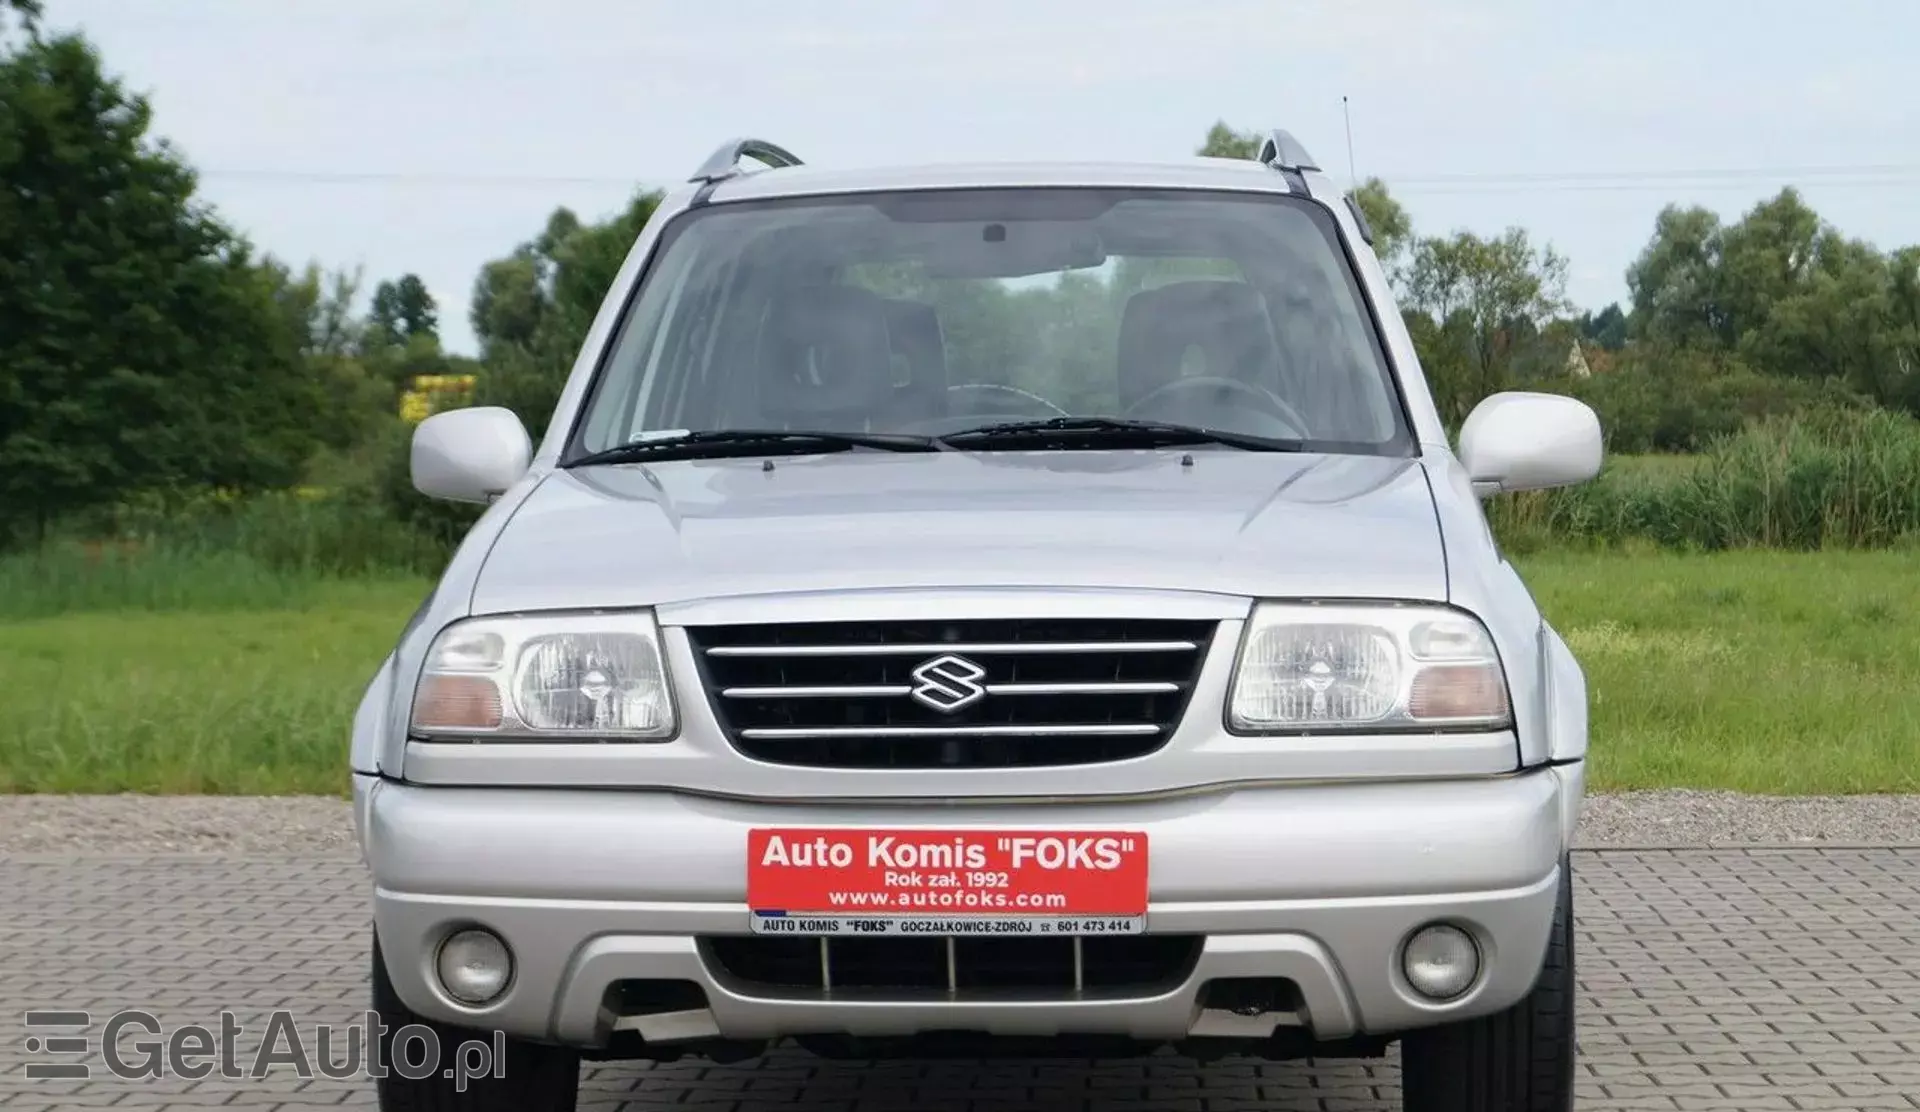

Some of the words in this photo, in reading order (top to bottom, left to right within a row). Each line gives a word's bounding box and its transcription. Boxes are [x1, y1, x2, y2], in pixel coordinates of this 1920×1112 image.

[761, 835, 853, 868] Auto
[868, 837, 986, 868] Komis
[997, 838, 1135, 870] "FOKS"
[884, 871, 922, 887] Rok
[928, 871, 961, 887] zał.
[965, 872, 1009, 887] 1992
[829, 890, 1066, 907] www.autofoks.com
[763, 919, 795, 931] AUTO
[799, 919, 839, 932] KOMIS
[1057, 921, 1078, 931] 601
[1083, 921, 1105, 931] 473
[1109, 921, 1131, 931] 414
